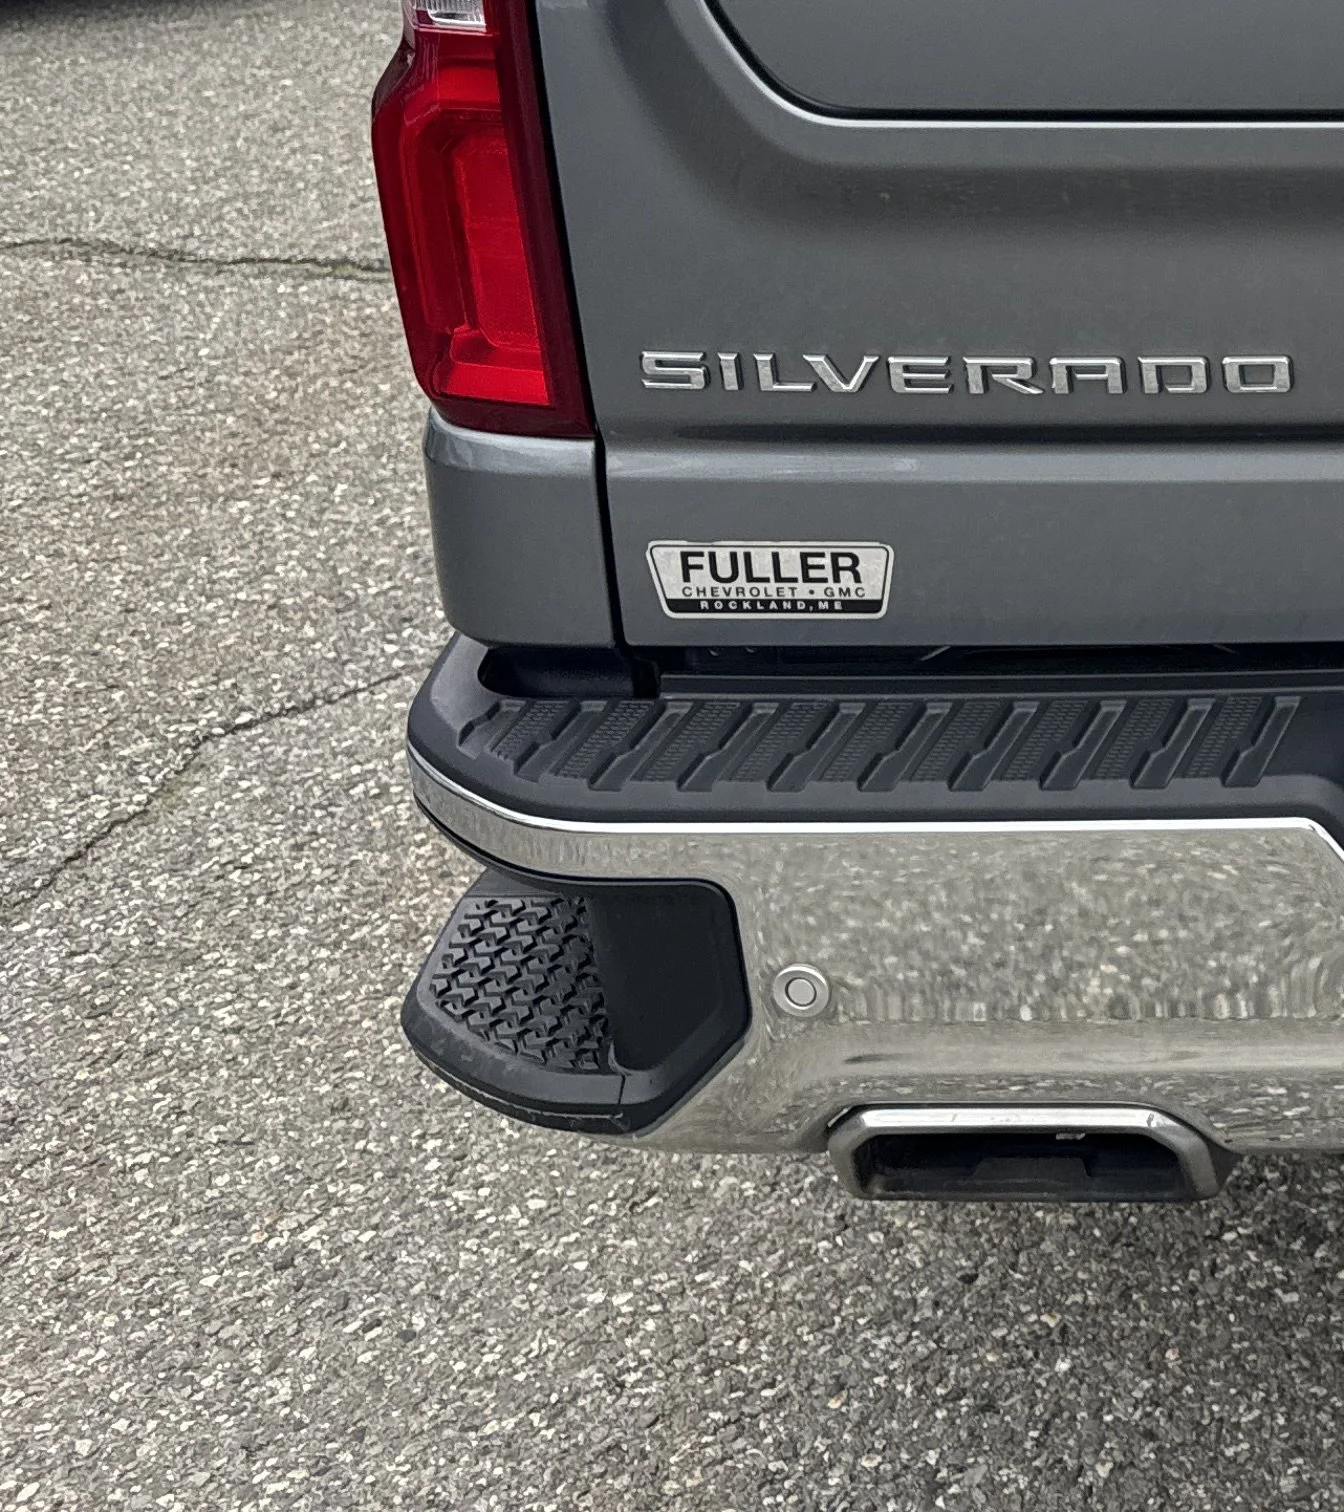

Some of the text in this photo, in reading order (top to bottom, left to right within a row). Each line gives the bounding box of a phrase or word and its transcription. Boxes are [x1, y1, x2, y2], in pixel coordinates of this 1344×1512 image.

[639, 349, 1294, 396] SILVERADO
[679, 550, 863, 584] FULLER
[681, 585, 867, 598] CHEVROLET GMC
